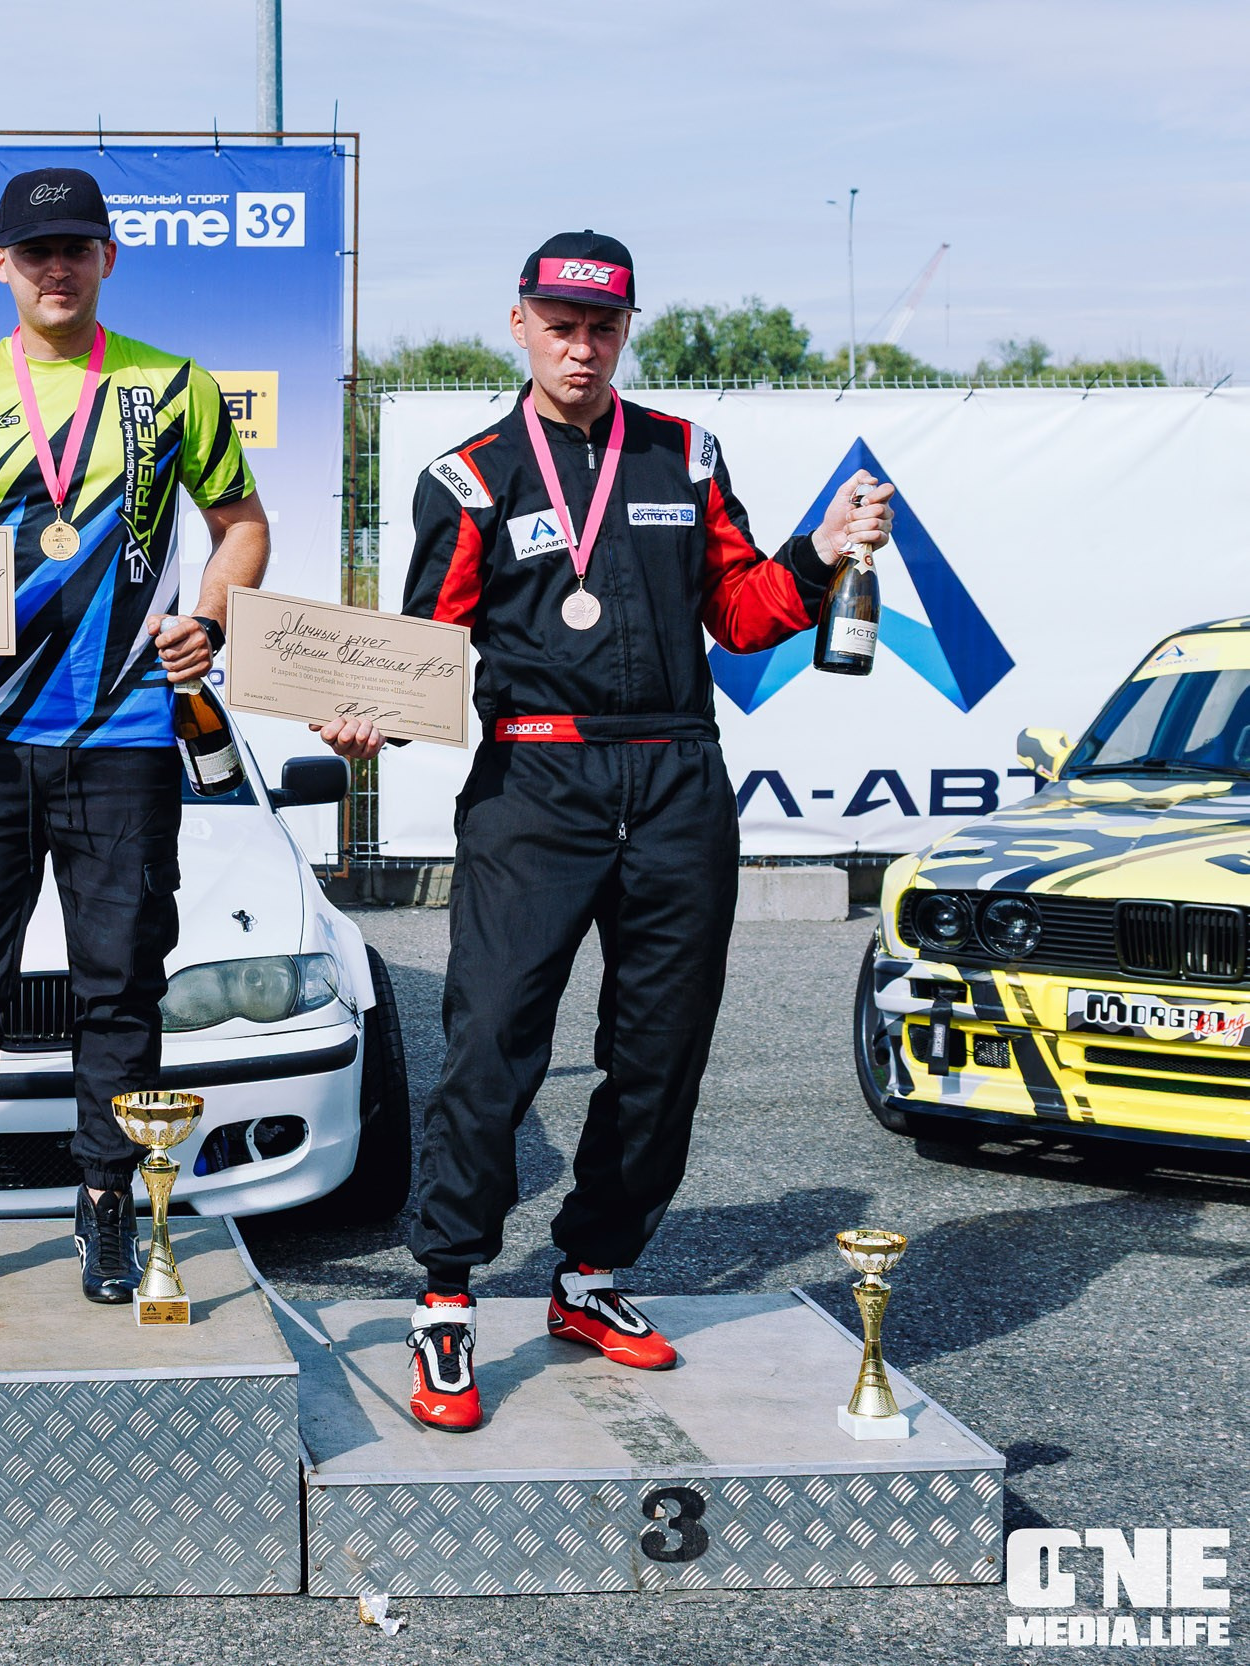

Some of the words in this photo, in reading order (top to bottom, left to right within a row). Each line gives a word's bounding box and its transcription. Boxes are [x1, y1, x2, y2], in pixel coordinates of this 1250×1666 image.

[187, 195, 229, 204] СПОРТ
[246, 203, 295, 239] 39
[557, 261, 615, 285] RDS
[120, 389, 131, 418] СПОРТ
[124, 421, 134, 513] АВТОМОБИЛЬНЫЙ
[125, 387, 156, 583] EXTREME39
[641, 1486, 709, 1562] 3
